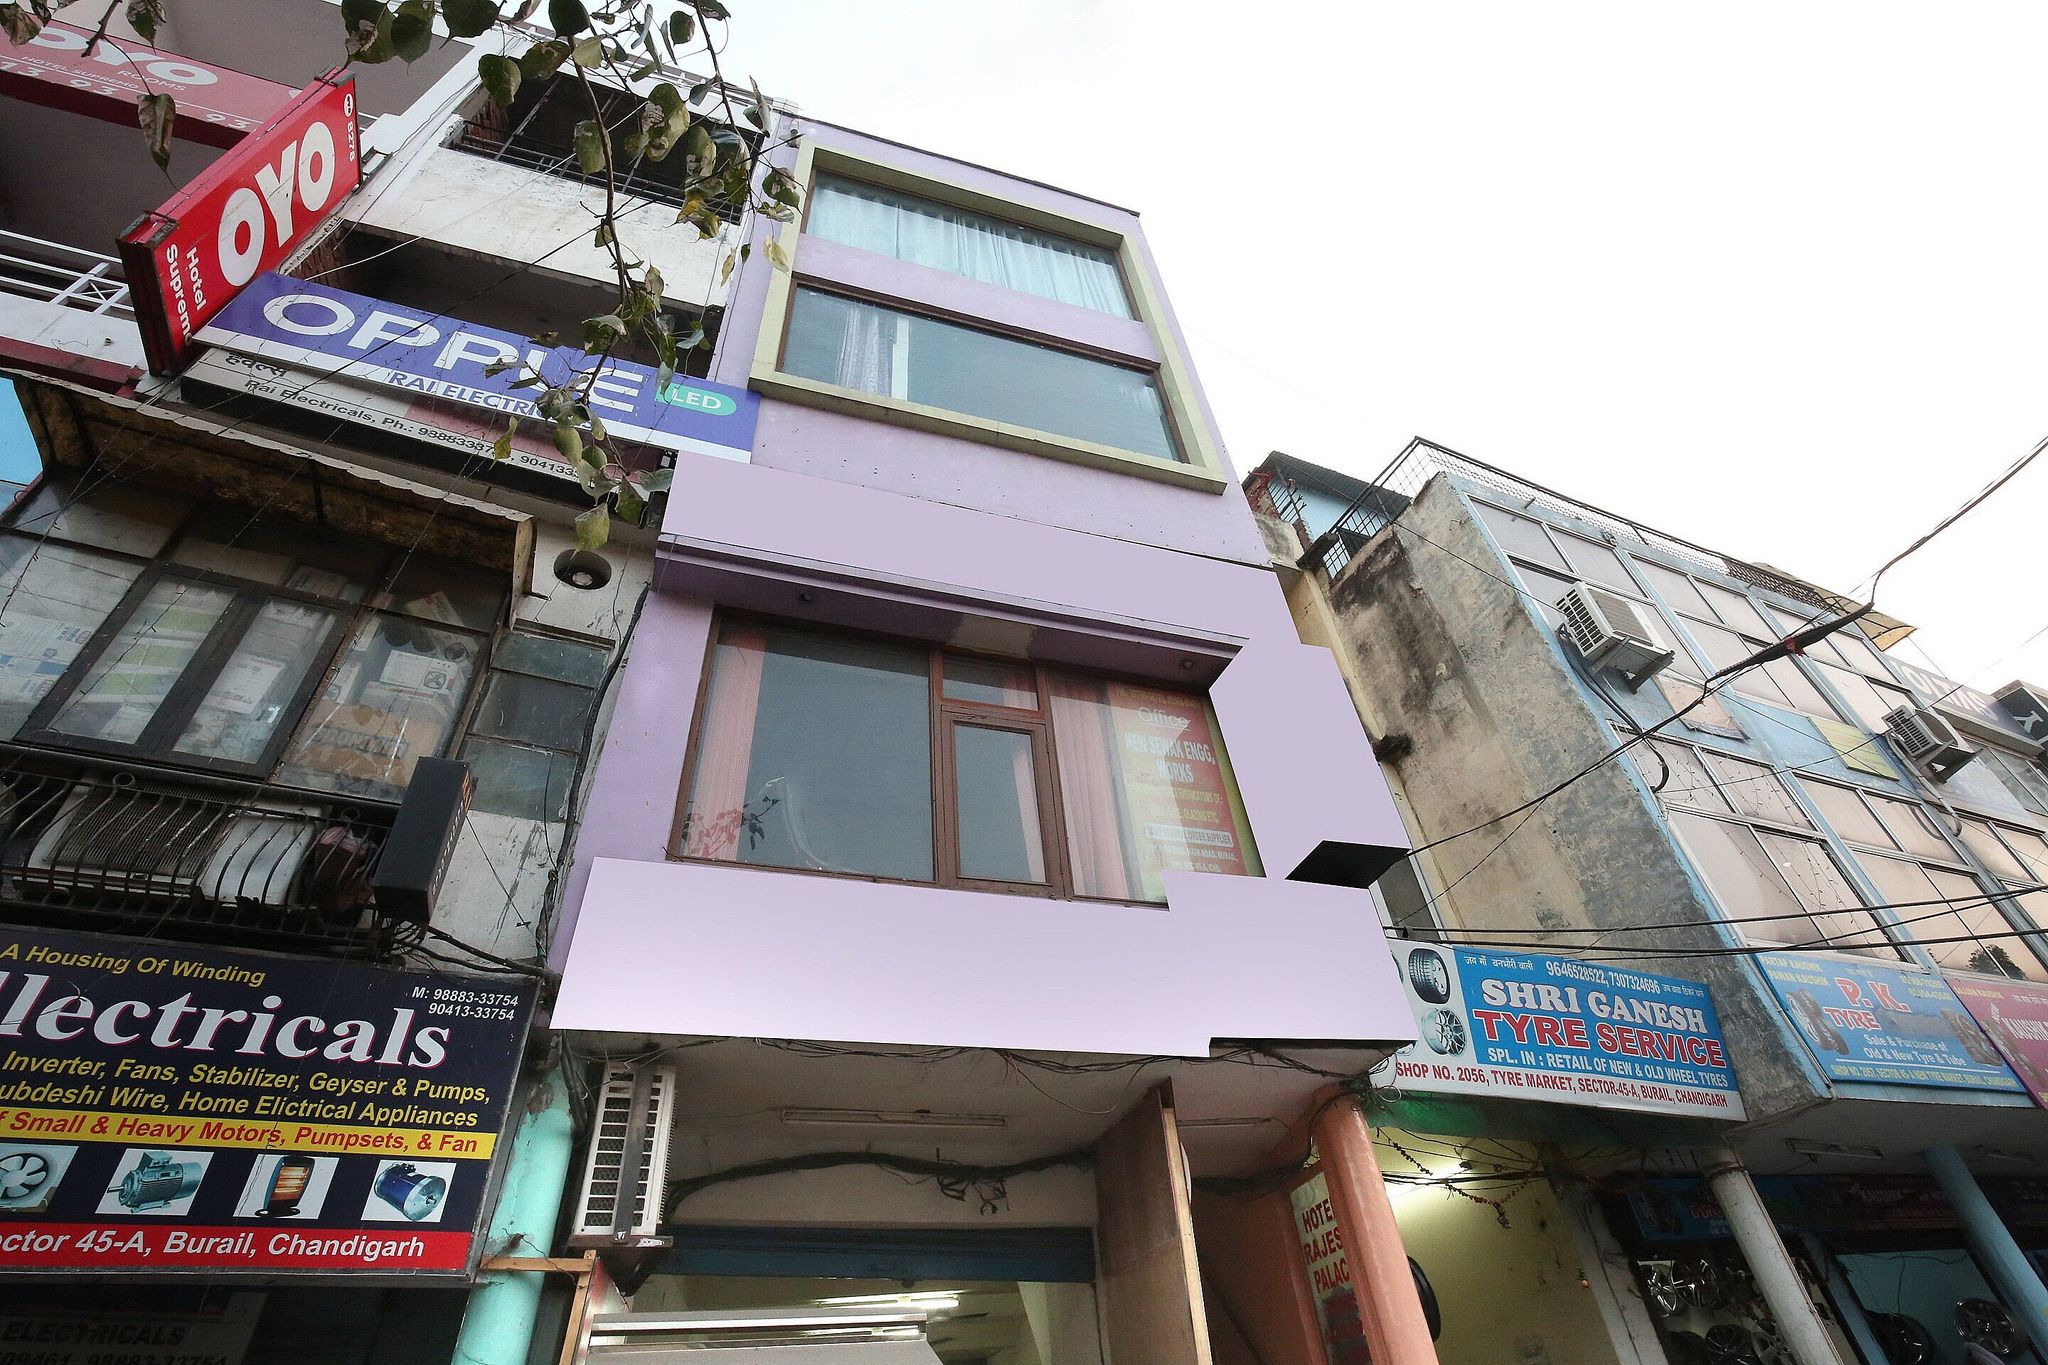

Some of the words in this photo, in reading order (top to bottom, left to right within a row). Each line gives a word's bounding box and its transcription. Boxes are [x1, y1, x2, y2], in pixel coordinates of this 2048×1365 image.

[21, 56, 69, 74] HOTEL
[74, 69, 139, 89] SUPREMO
[117, 70, 187, 91] ROOMS
[218, 122, 335, 287] OYO
[166, 243, 193, 347] Supremo
[186, 246, 207, 311] Hotel
[263, 294, 644, 412] OPPLE
[388, 371, 438, 392] RAI
[671, 388, 722, 410] LED
[244, 380, 277, 395] Rai
[279, 383, 377, 424] Electricals,
[1139, 707, 1191, 729] Office
[1156, 760, 1194, 783] WORKS
[0, 943, 18, 960] A
[26, 946, 131, 974] Housing
[138, 957, 170, 974] Of
[173, 960, 266, 988] Winding
[412, 987, 429, 1000] M:
[433, 988, 518, 1007] 98883-33754
[429, 1002, 514, 1021] 90413-33754
[1481, 978, 1582, 1014] SHRI
[1587, 991, 1708, 1034] GANESH
[1835, 977, 1874, 1008] P.
[1867, 981, 1912, 1013] K.
[0, 970, 450, 1068] lectricals
[1822, 1007, 1883, 1031] TYRE
[1473, 1009, 1591, 1050] TYRE
[1596, 1022, 1727, 1069] SERVICE
[1863, 1034, 1885, 1046] Sale
[1886, 1036, 1896, 1047] &
[1896, 1037, 1939, 1051] Purchase
[1863, 1047, 1880, 1059] Old
[1882, 1048, 1892, 1060] &
[1892, 1049, 1913, 1061] New
[1912, 1051, 1935, 1065] Tyre
[1943, 1054, 1967, 1066] Tube
[2, 1051, 107, 1079] Inverter,
[115, 1058, 181, 1084] Fans,
[188, 1064, 300, 1092] Stabilizer,
[309, 1072, 388, 1096] Geyser
[391, 1078, 408, 1097] &
[413, 1079, 491, 1105] Pumps,
[1396, 1062, 1429, 1079] SHOP
[1433, 1065, 1455, 1081] NO.
[1458, 1067, 1490, 1086] 2056,
[1491, 1070, 1523, 1087] TYRE
[1525, 1073, 1576, 1094] MARKET,
[1579, 1078, 1641, 1101] SECTOR-45-A,
[1641, 1085, 1676, 1105] BURAIL,
[1676, 1089, 1728, 1108] CHANDIGARH
[1488, 1047, 1518, 1064] SPL.
[1522, 1050, 1536, 1066] IN
[1545, 1052, 1593, 1071] RETAIL
[1593, 1057, 1607, 1072] OF
[1610, 1060, 1632, 1076] NEW
[1635, 1064, 1644, 1077] &
[1645, 1065, 1664, 1080] OLD
[1665, 1067, 1699, 1084] WHEEL
[1699, 1071, 1729, 1087] TYRES
[109, 1086, 170, 1112] Wire,
[178, 1091, 250, 1114] Home
[255, 1095, 357, 1120] Elictrical
[359, 1101, 479, 1127] Appliances
[10, 1111, 87, 1134] Small
[90, 1116, 110, 1135] &
[116, 1117, 195, 1143] Heavy
[199, 1121, 286, 1146] Motors,
[294, 1126, 410, 1152] Pumpsets,
[416, 1133, 432, 1151] &
[439, 1134, 478, 1153] Fan
[0, 1229, 71, 1252] ctor
[75, 1229, 152, 1257] 45-A,
[163, 1231, 256, 1259] Burail,
[268, 1233, 425, 1263] Chandigarh
[1303, 1227, 1344, 1265] RAJES
[1313, 1257, 1350, 1294] PALAC
